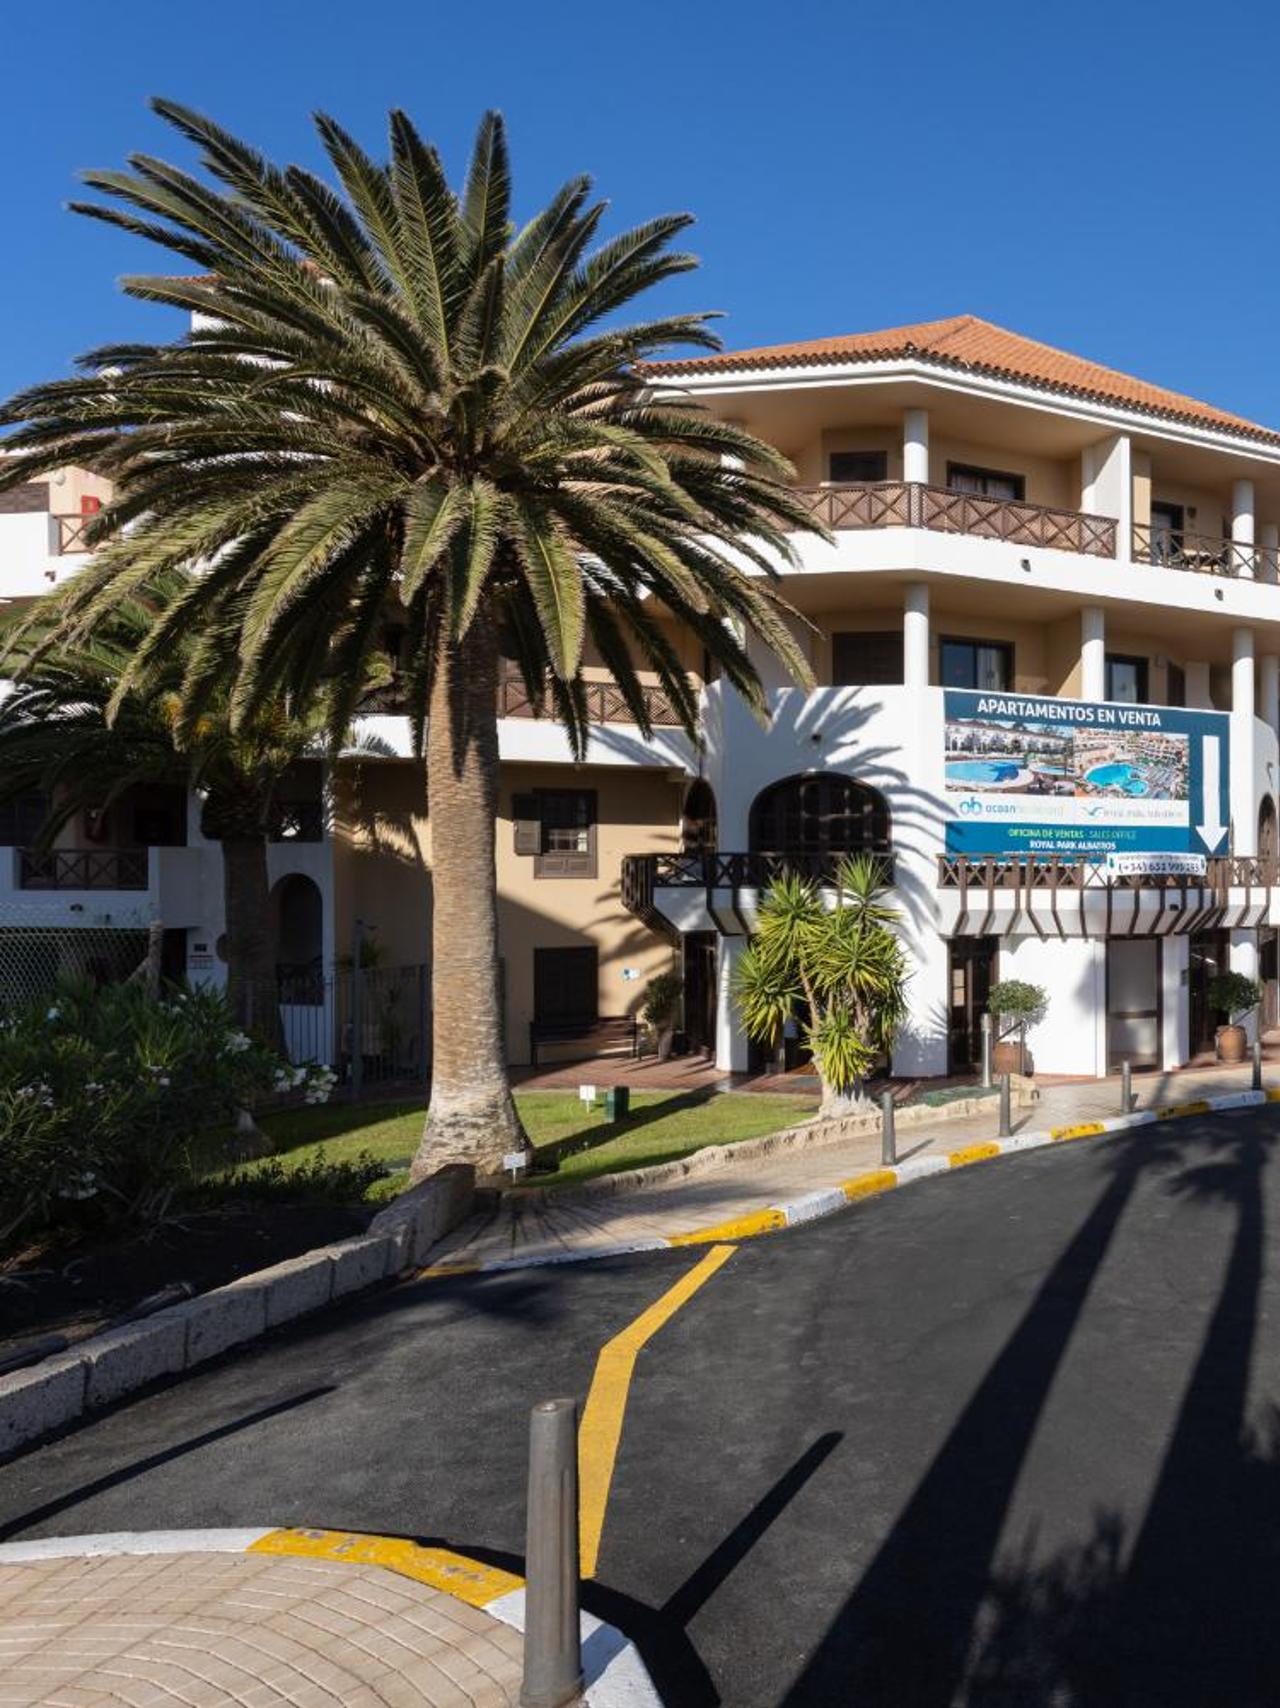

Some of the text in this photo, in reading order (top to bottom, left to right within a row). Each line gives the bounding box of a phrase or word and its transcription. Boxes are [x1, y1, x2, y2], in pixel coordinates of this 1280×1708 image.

[977, 698, 1161, 727] APARTAMENTOS EN VENTA
[1008, 828, 1040, 838] OFICINA
[1042, 829, 1054, 838] DE
[1055, 829, 1084, 838] VENTAS
[1029, 840, 1116, 850] ROYAL PARK ALBATROS
